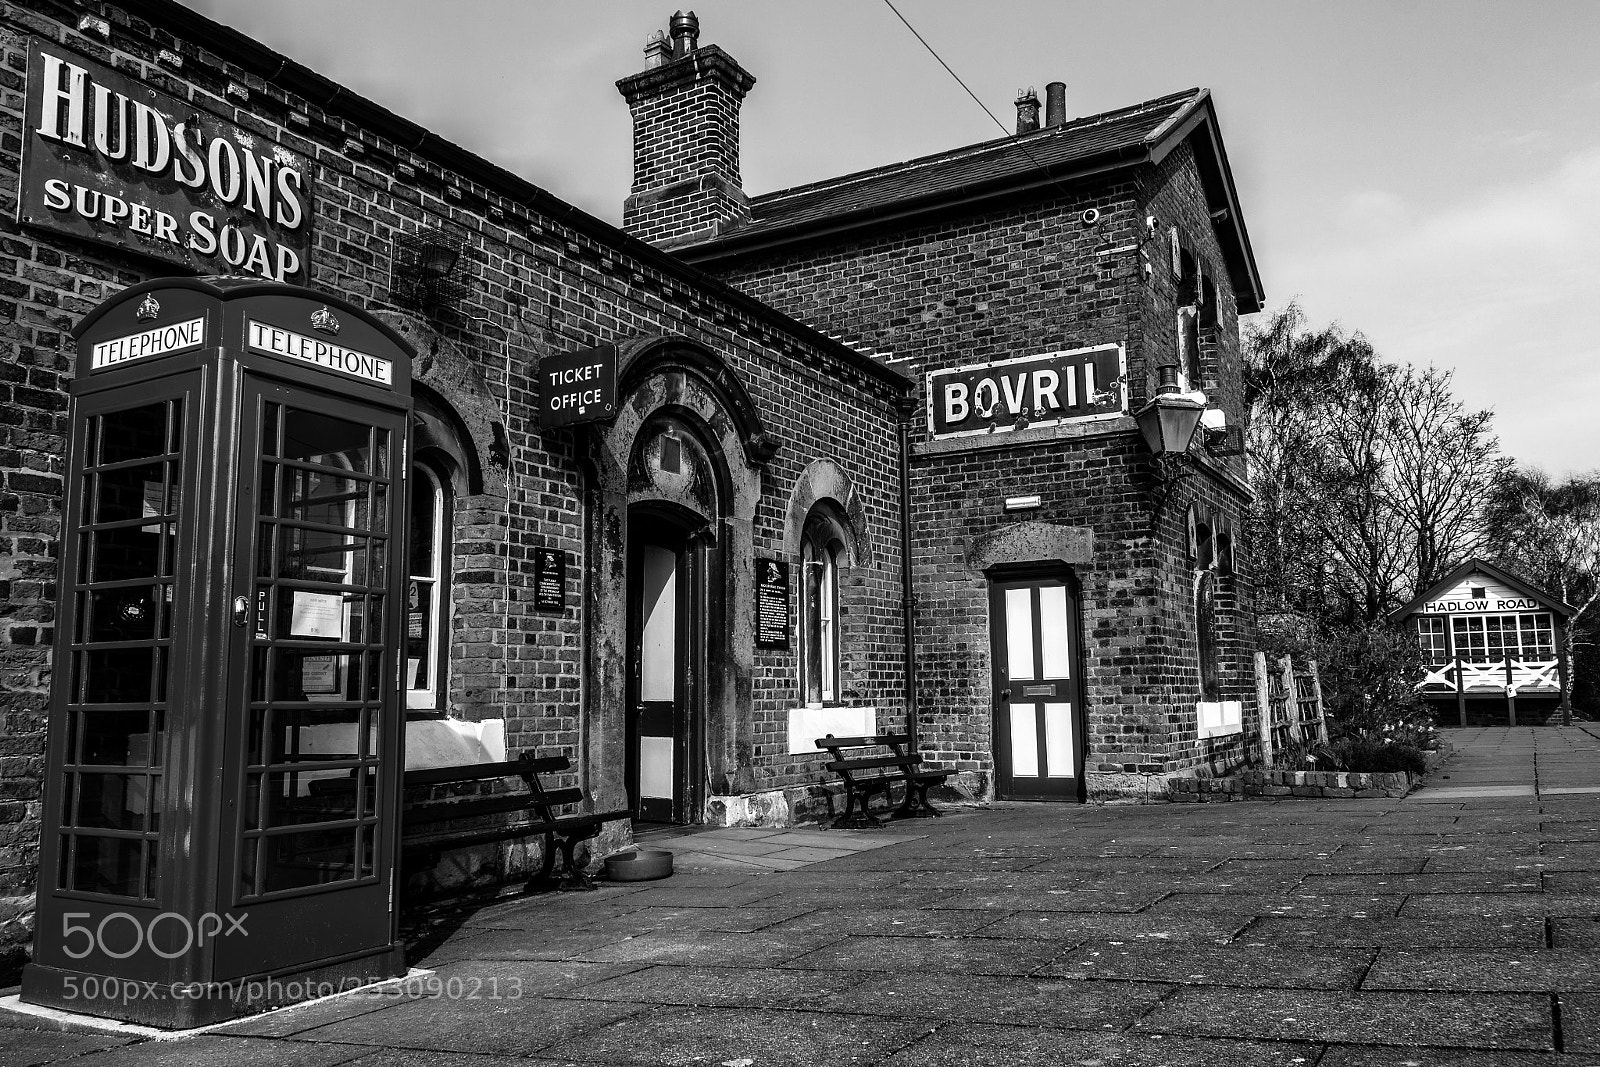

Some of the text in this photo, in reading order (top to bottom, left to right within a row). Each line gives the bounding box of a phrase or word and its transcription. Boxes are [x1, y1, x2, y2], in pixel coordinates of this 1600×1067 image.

[44, 178, 300, 283] SUPER SOAP
[98, 320, 202, 367] TELEPHONE
[253, 323, 387, 381] TELEPHONE
[549, 363, 604, 387] TICKET
[944, 362, 1116, 424] BOVRIL
[550, 388, 602, 411] OFFICE
[258, 591, 266, 632] PULL
[1425, 599, 1537, 612] HADLOW ROAD
